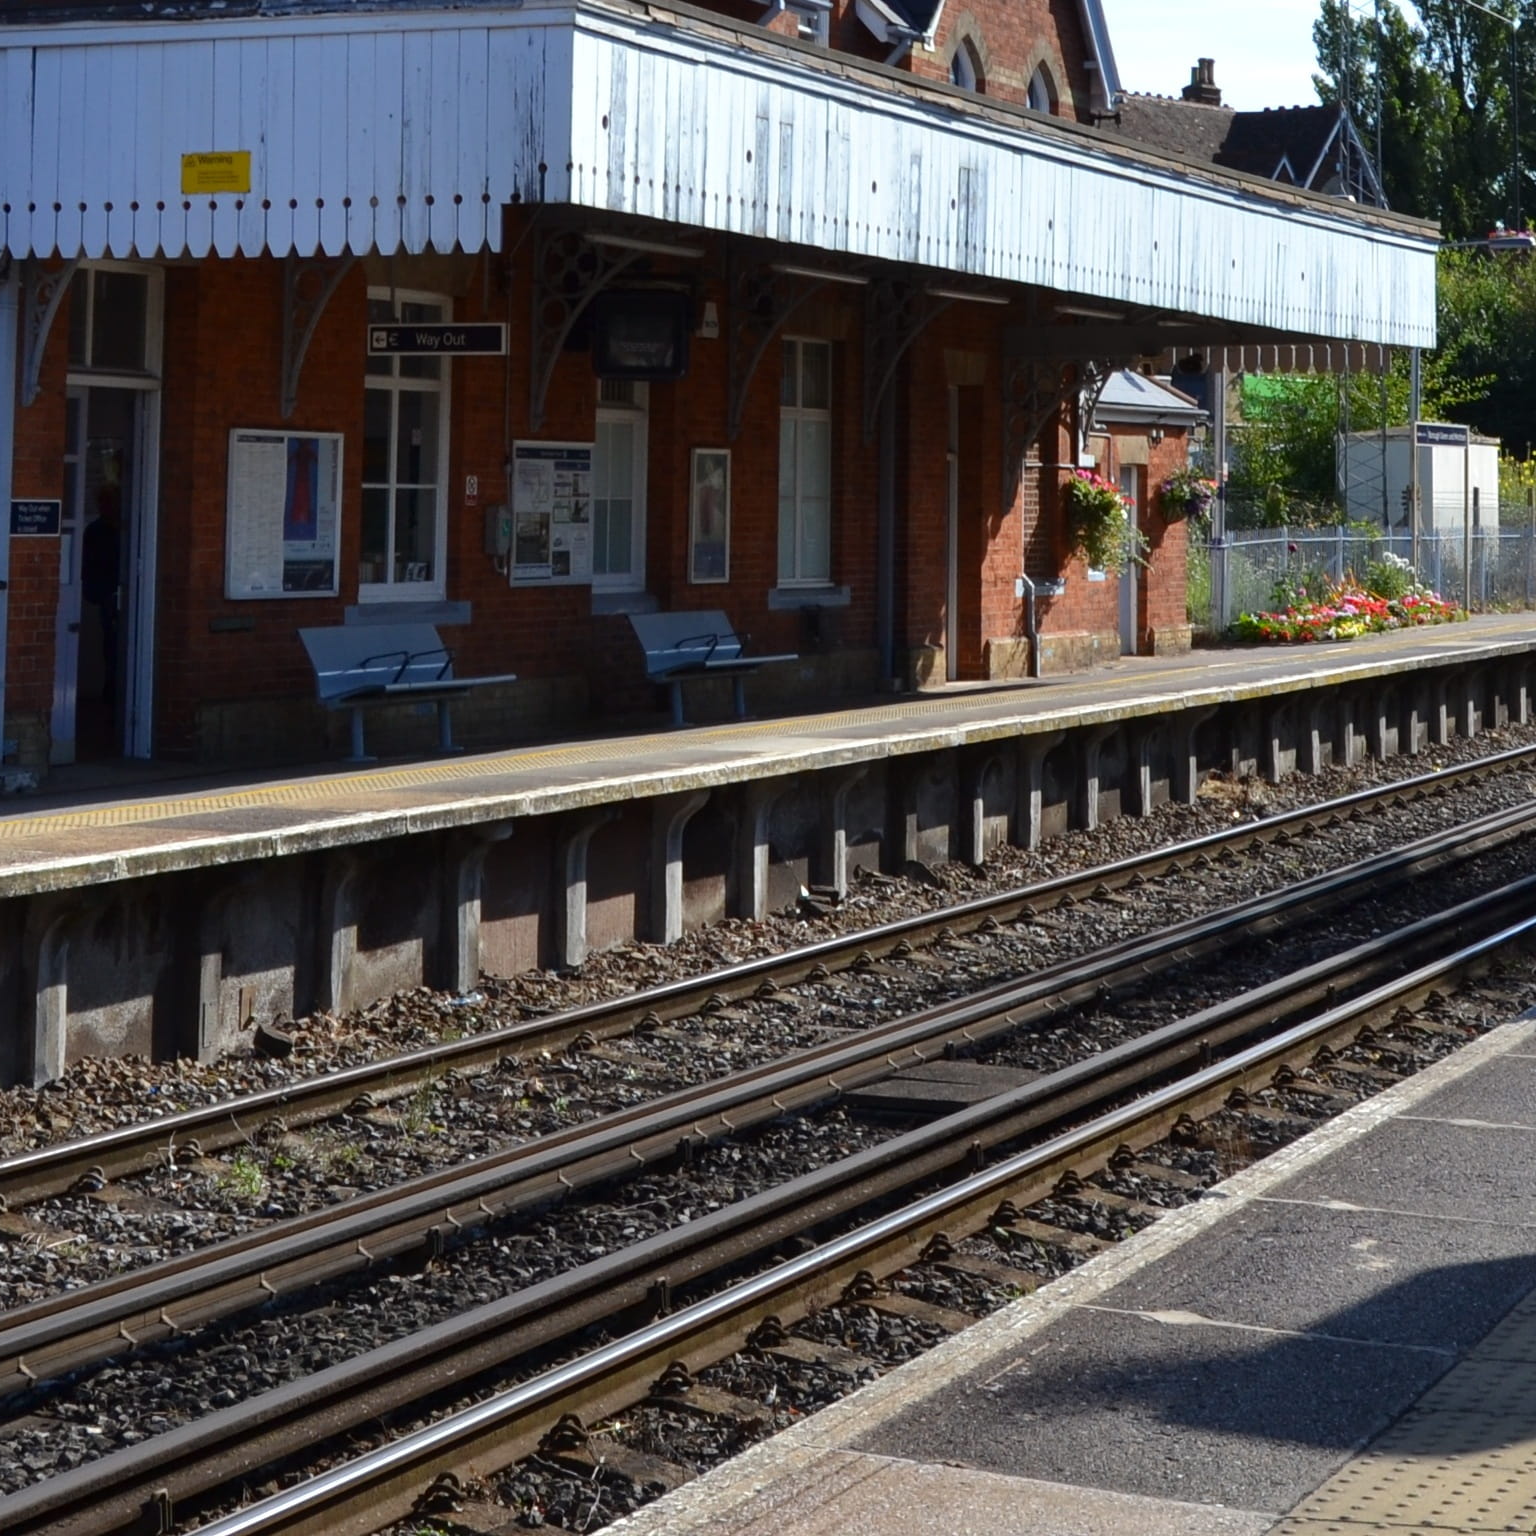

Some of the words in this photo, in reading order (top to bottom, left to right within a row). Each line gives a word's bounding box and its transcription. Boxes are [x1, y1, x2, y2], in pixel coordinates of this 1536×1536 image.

[198, 155, 233, 165] Warning
[415, 333, 441, 349] Way
[442, 332, 466, 346] Out
[17, 505, 28, 513] Way
